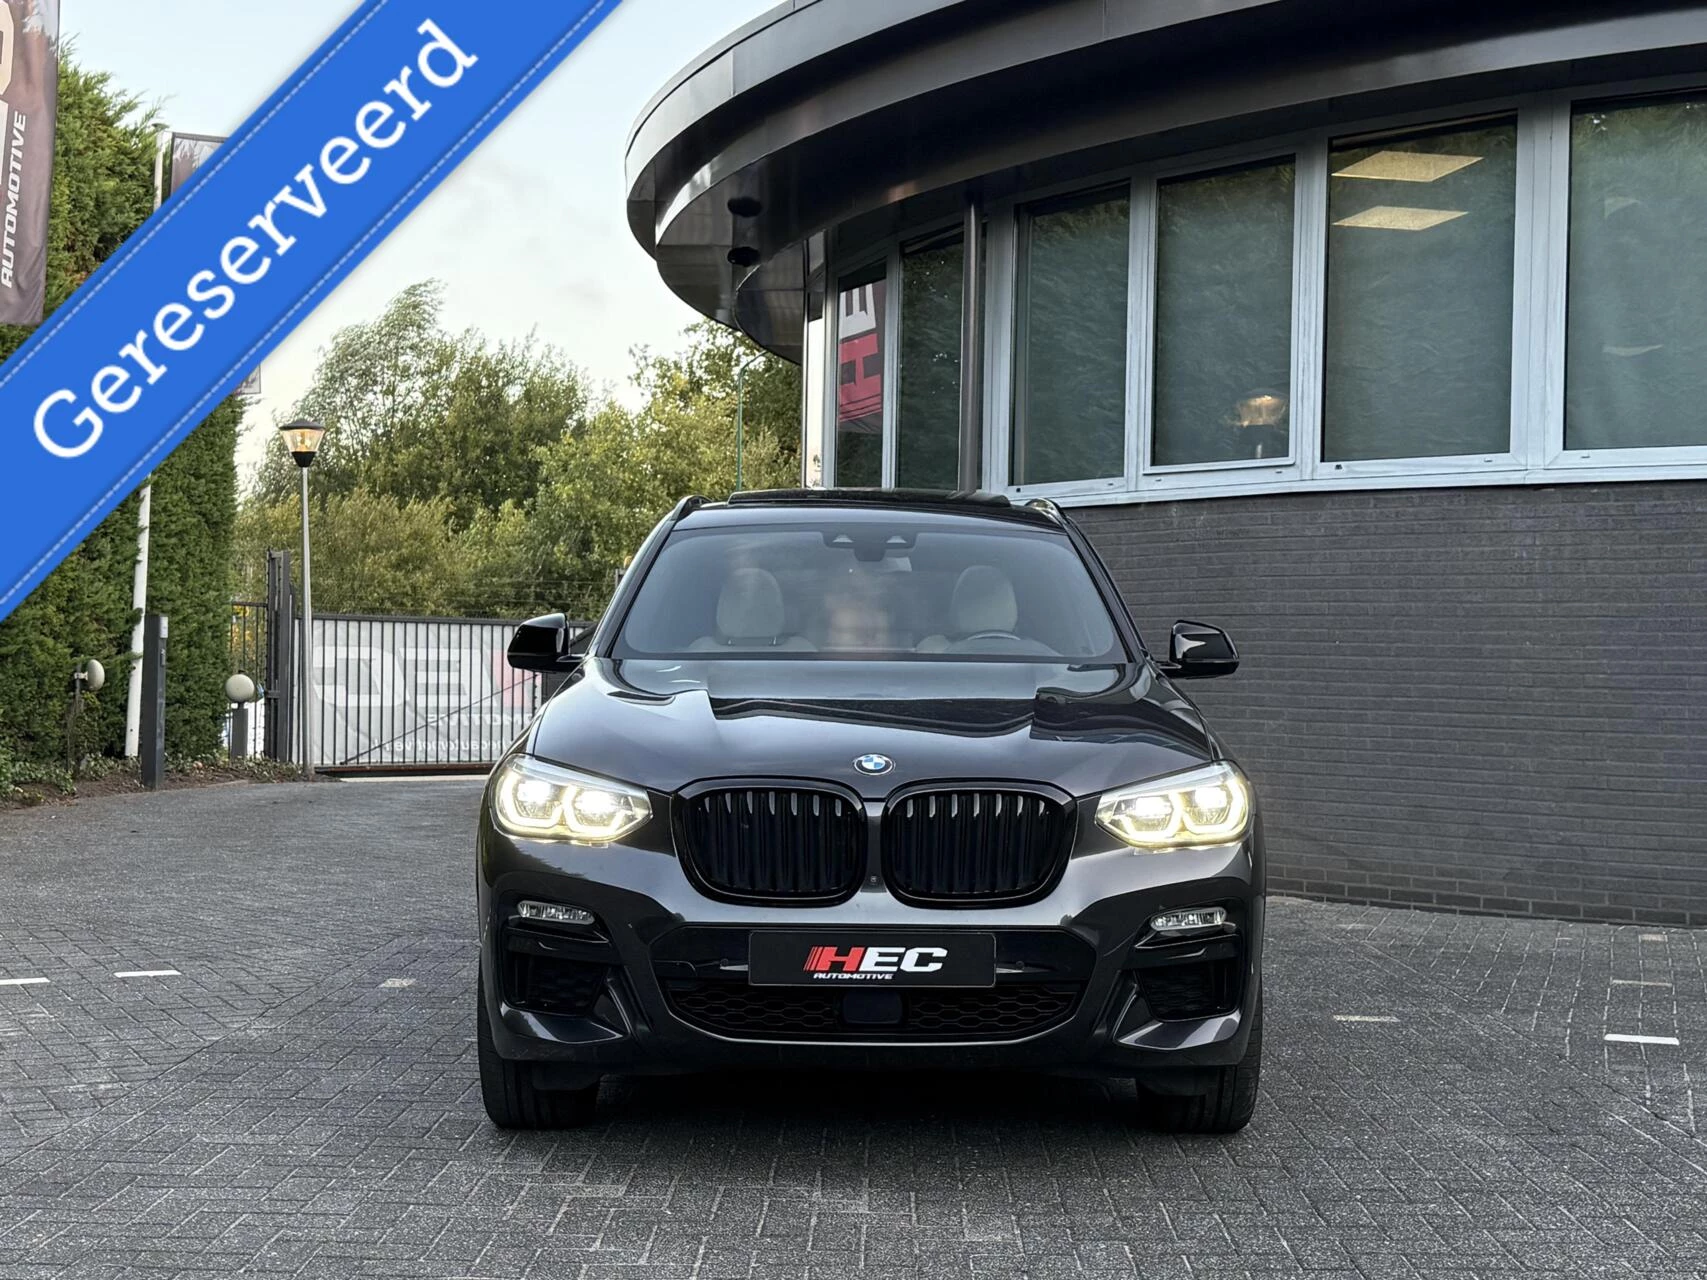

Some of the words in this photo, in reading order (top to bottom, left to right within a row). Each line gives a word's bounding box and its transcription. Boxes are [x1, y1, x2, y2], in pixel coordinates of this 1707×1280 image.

[1, 110, 27, 289] AUTOMOTIVE
[803, 946, 948, 972] HEC
[813, 972, 895, 981] AUTOMOTIVE
